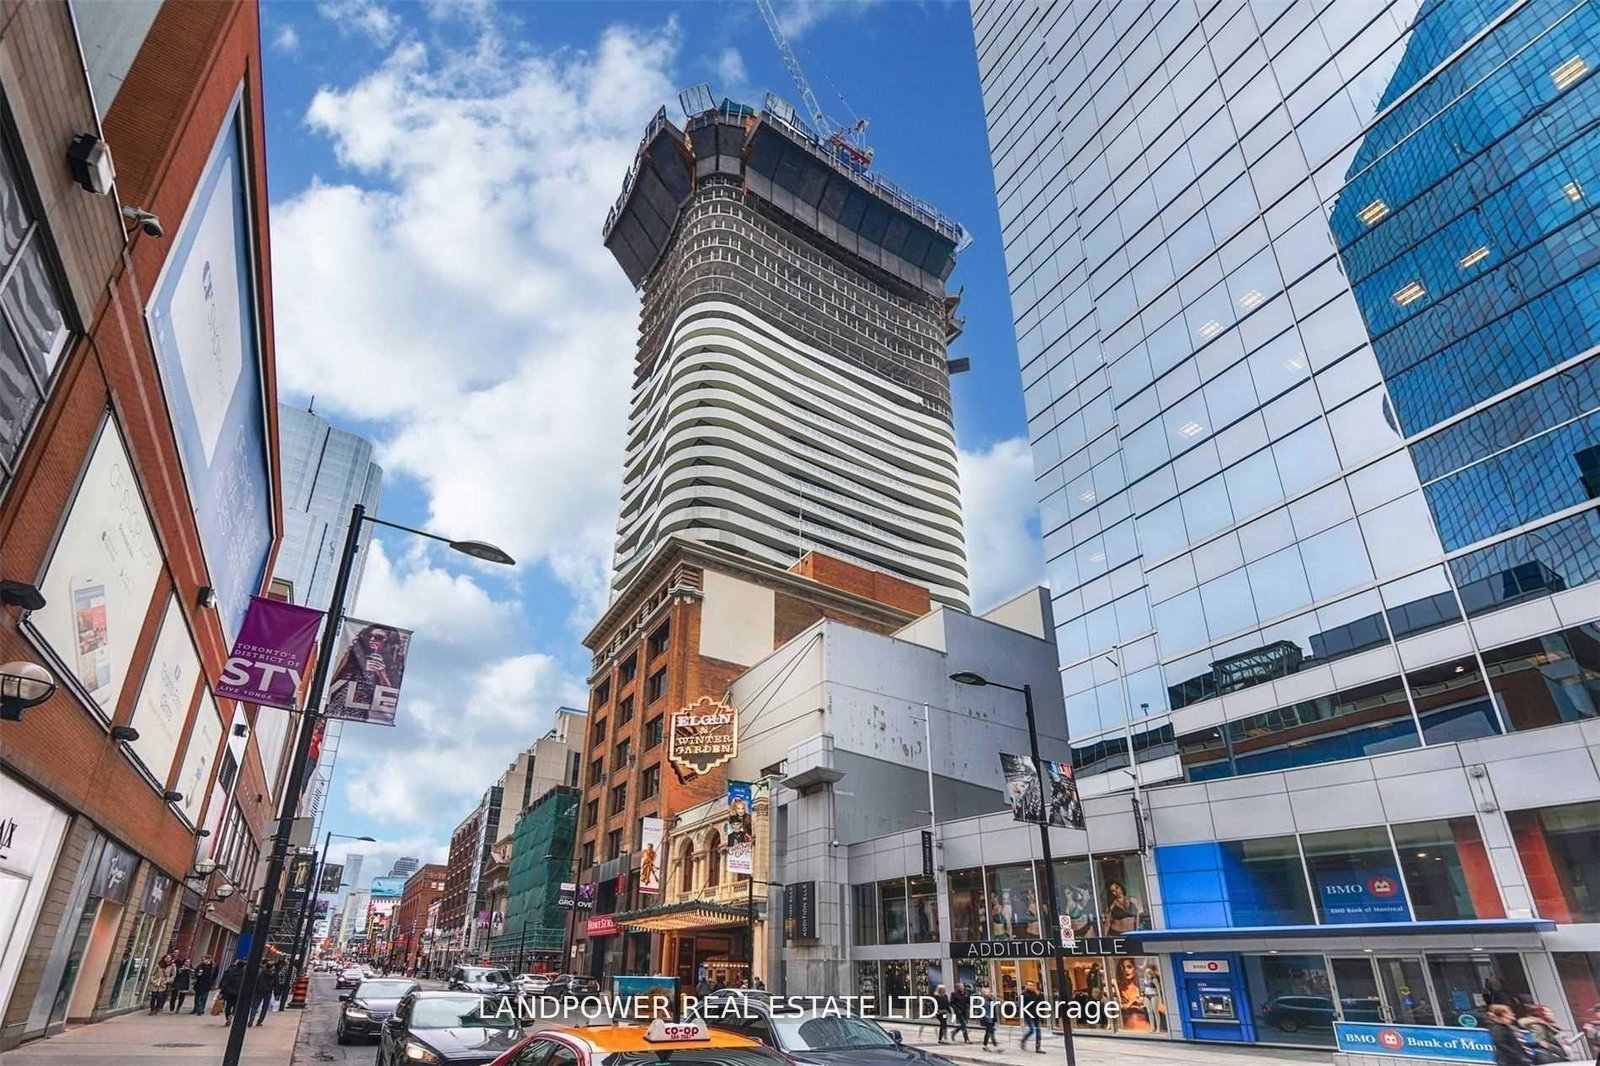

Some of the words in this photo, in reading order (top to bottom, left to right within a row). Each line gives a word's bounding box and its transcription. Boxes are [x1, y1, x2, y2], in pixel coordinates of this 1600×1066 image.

[234, 649, 284, 664] DISTRICT
[236, 643, 297, 660] TORONTO'S
[220, 685, 240, 694] LIVE
[243, 689, 273, 701] YONGE
[676, 713, 732, 727] ELGIN
[676, 734, 732, 745] WINTER
[675, 744, 731, 755] GARDEN
[1326, 884, 1363, 895] BMO
[1373, 905, 1404, 913] Montreal
[967, 940, 1056, 957] ADDITION
[1070, 938, 1128, 955] ELLE
[664, 1026, 700, 1037] co-op
[1345, 1033, 1376, 1044] BMO
[1407, 1037, 1442, 1049] Bank
[1444, 1038, 1459, 1049] of
[1460, 1037, 1497, 1052] Mon
